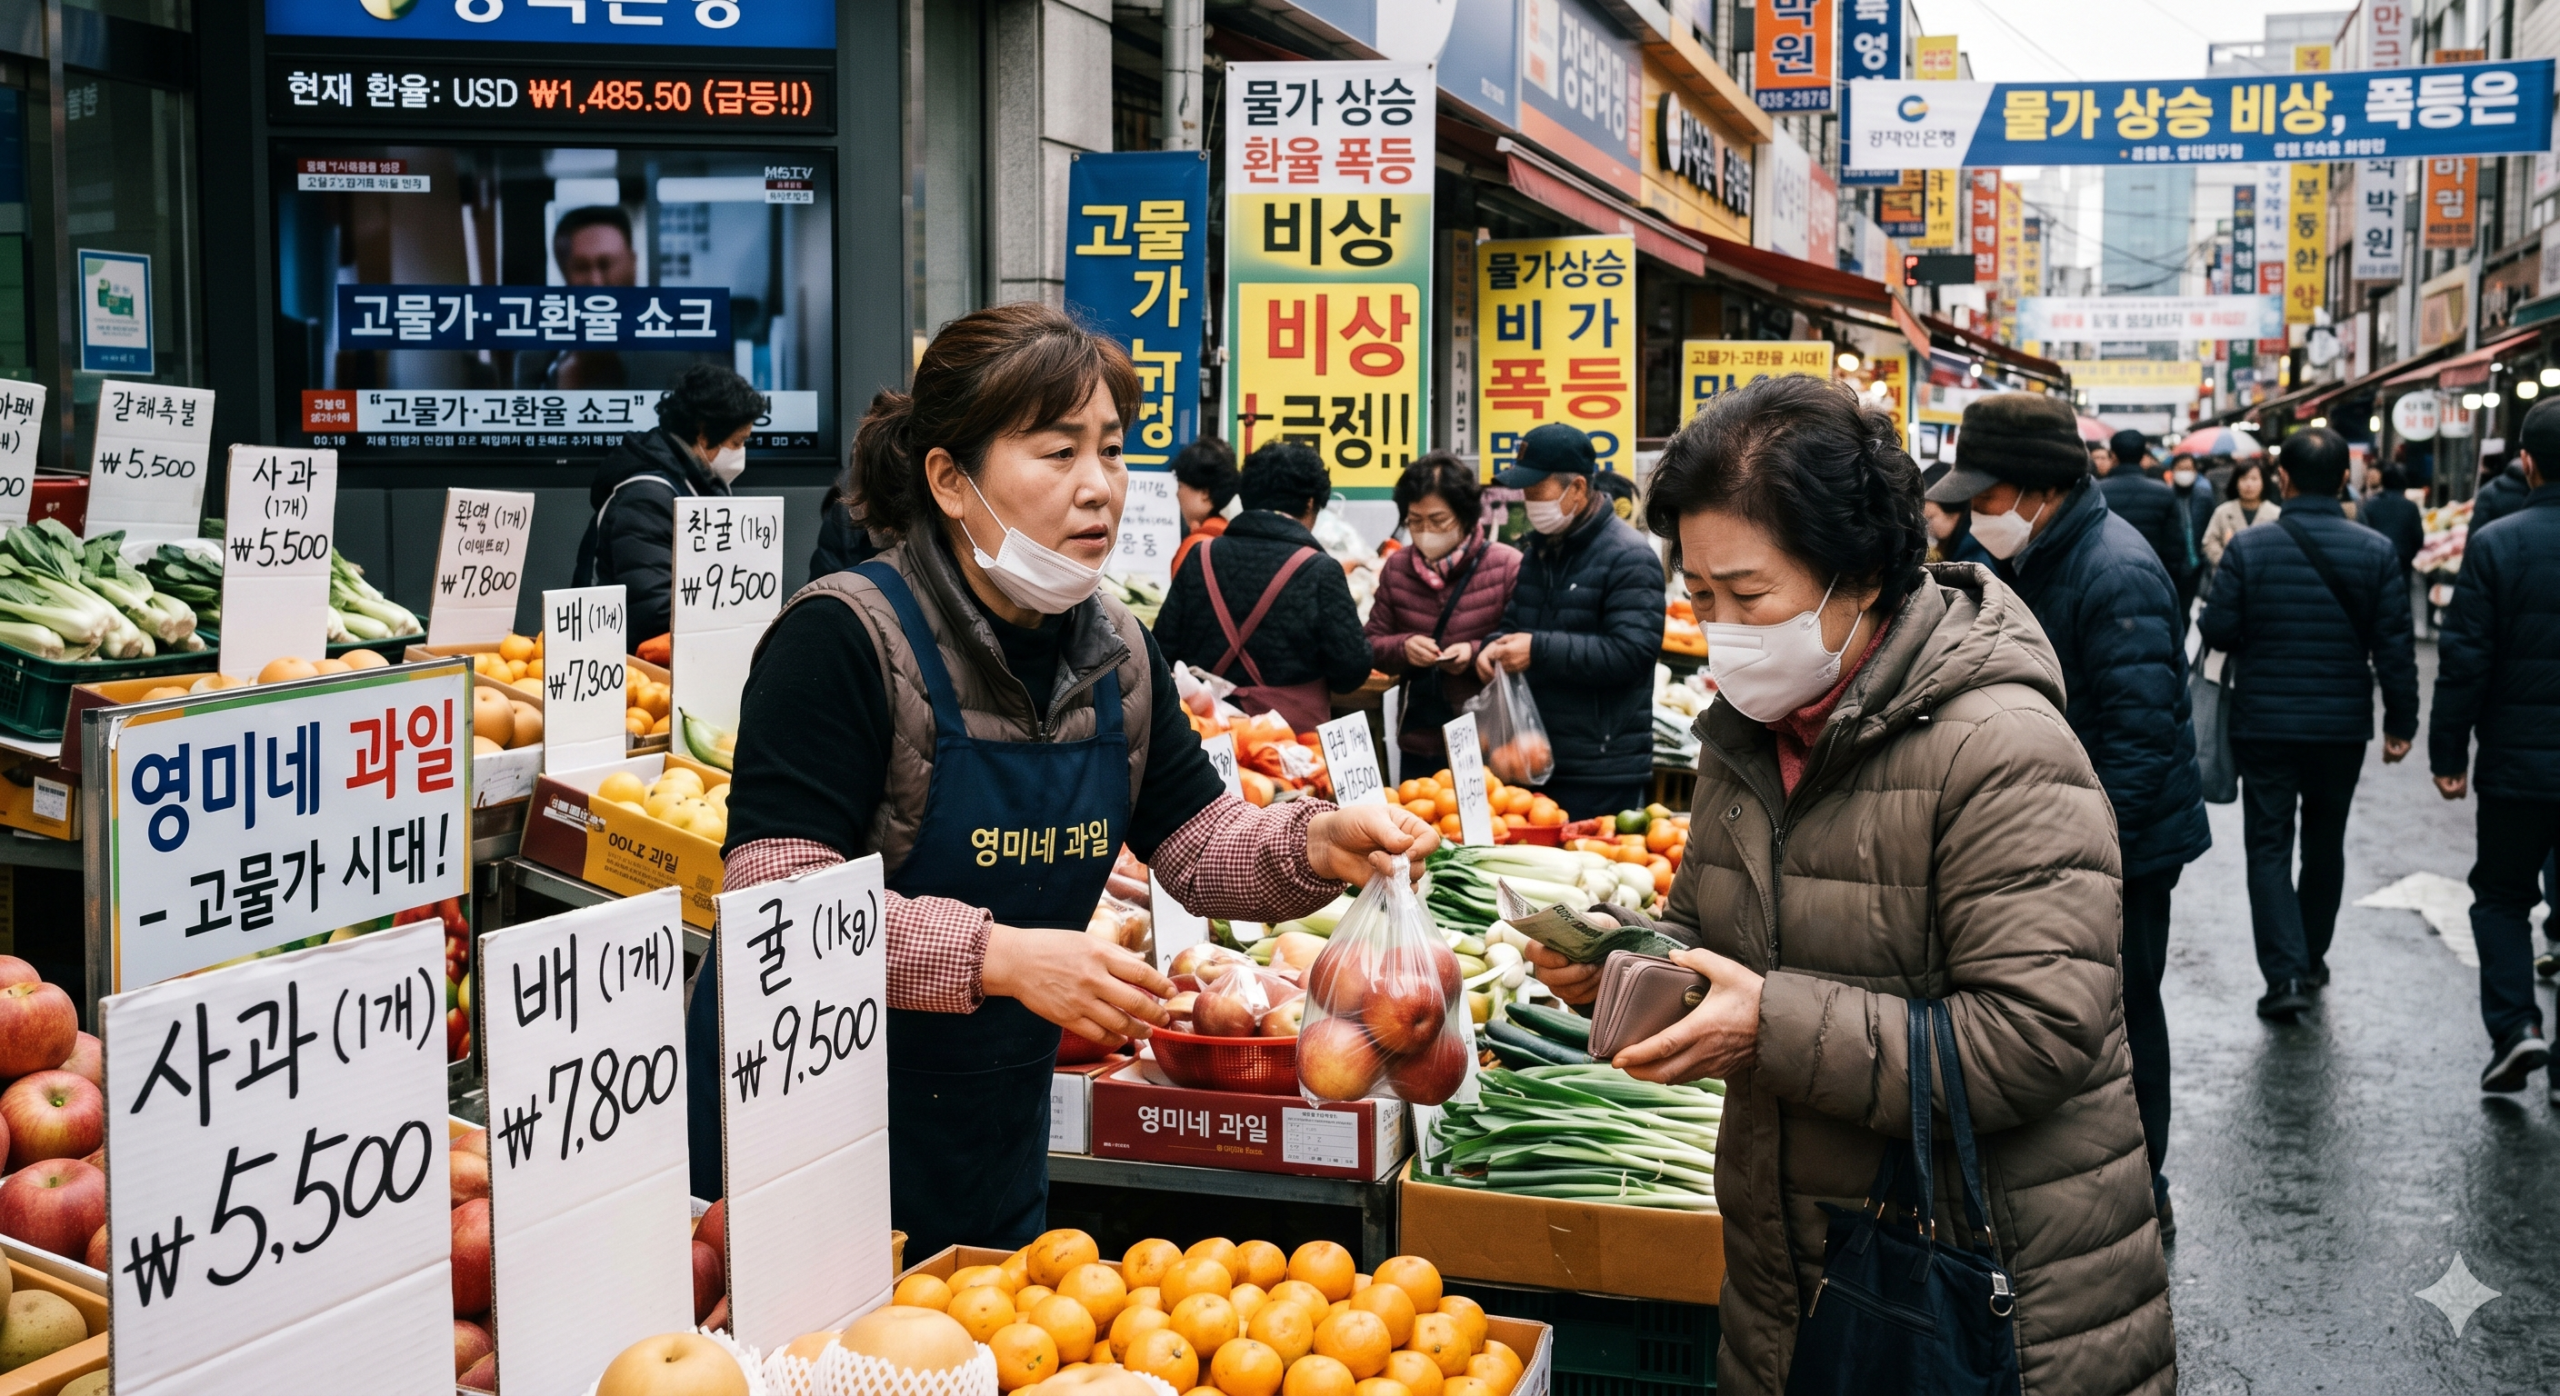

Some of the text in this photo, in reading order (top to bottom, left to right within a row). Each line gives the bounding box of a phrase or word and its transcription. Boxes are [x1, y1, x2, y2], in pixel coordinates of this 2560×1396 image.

[288, 72, 812, 116] 현재 환율: USD ₩1,485.50 (급등!!)
[1242, 79, 1416, 126] 물가 상승
[2003, 70, 2519, 140] 물가 상승 비상, 폭등은
[1243, 136, 1415, 184] 환율 폭등
[1263, 198, 1400, 267] 비상
[1486, 249, 1626, 290] 물가상승
[350, 294, 717, 342] 고물가·고환율 쇼크
[1268, 294, 1411, 376] 비상
[252, 456, 318, 493] 사과
[264, 495, 308, 521] (1개)
[741, 514, 777, 549] (1kg)
[230, 527, 328, 568] ₩5,500
[441, 565, 517, 598] ₩7,800
[681, 563, 776, 610] ₩9,500
[557, 597, 582, 642] 배
[131, 698, 454, 853] 영미네 과일
[971, 818, 1108, 867] 영미네 과일
[185, 839, 325, 938] 고물가
[342, 813, 449, 896] 시대!
[747, 888, 877, 997] 귤 (1kg)
[513, 925, 674, 1033] 배 (1개)
[130, 967, 435, 1127] 사과 (1개)
[732, 997, 876, 1103] ₩9,500
[498, 1044, 677, 1169] ₩7,800
[1138, 1105, 1210, 1139] 영미네
[1219, 1112, 1268, 1144] 과일
[123, 1119, 431, 1307] ₩5,500
